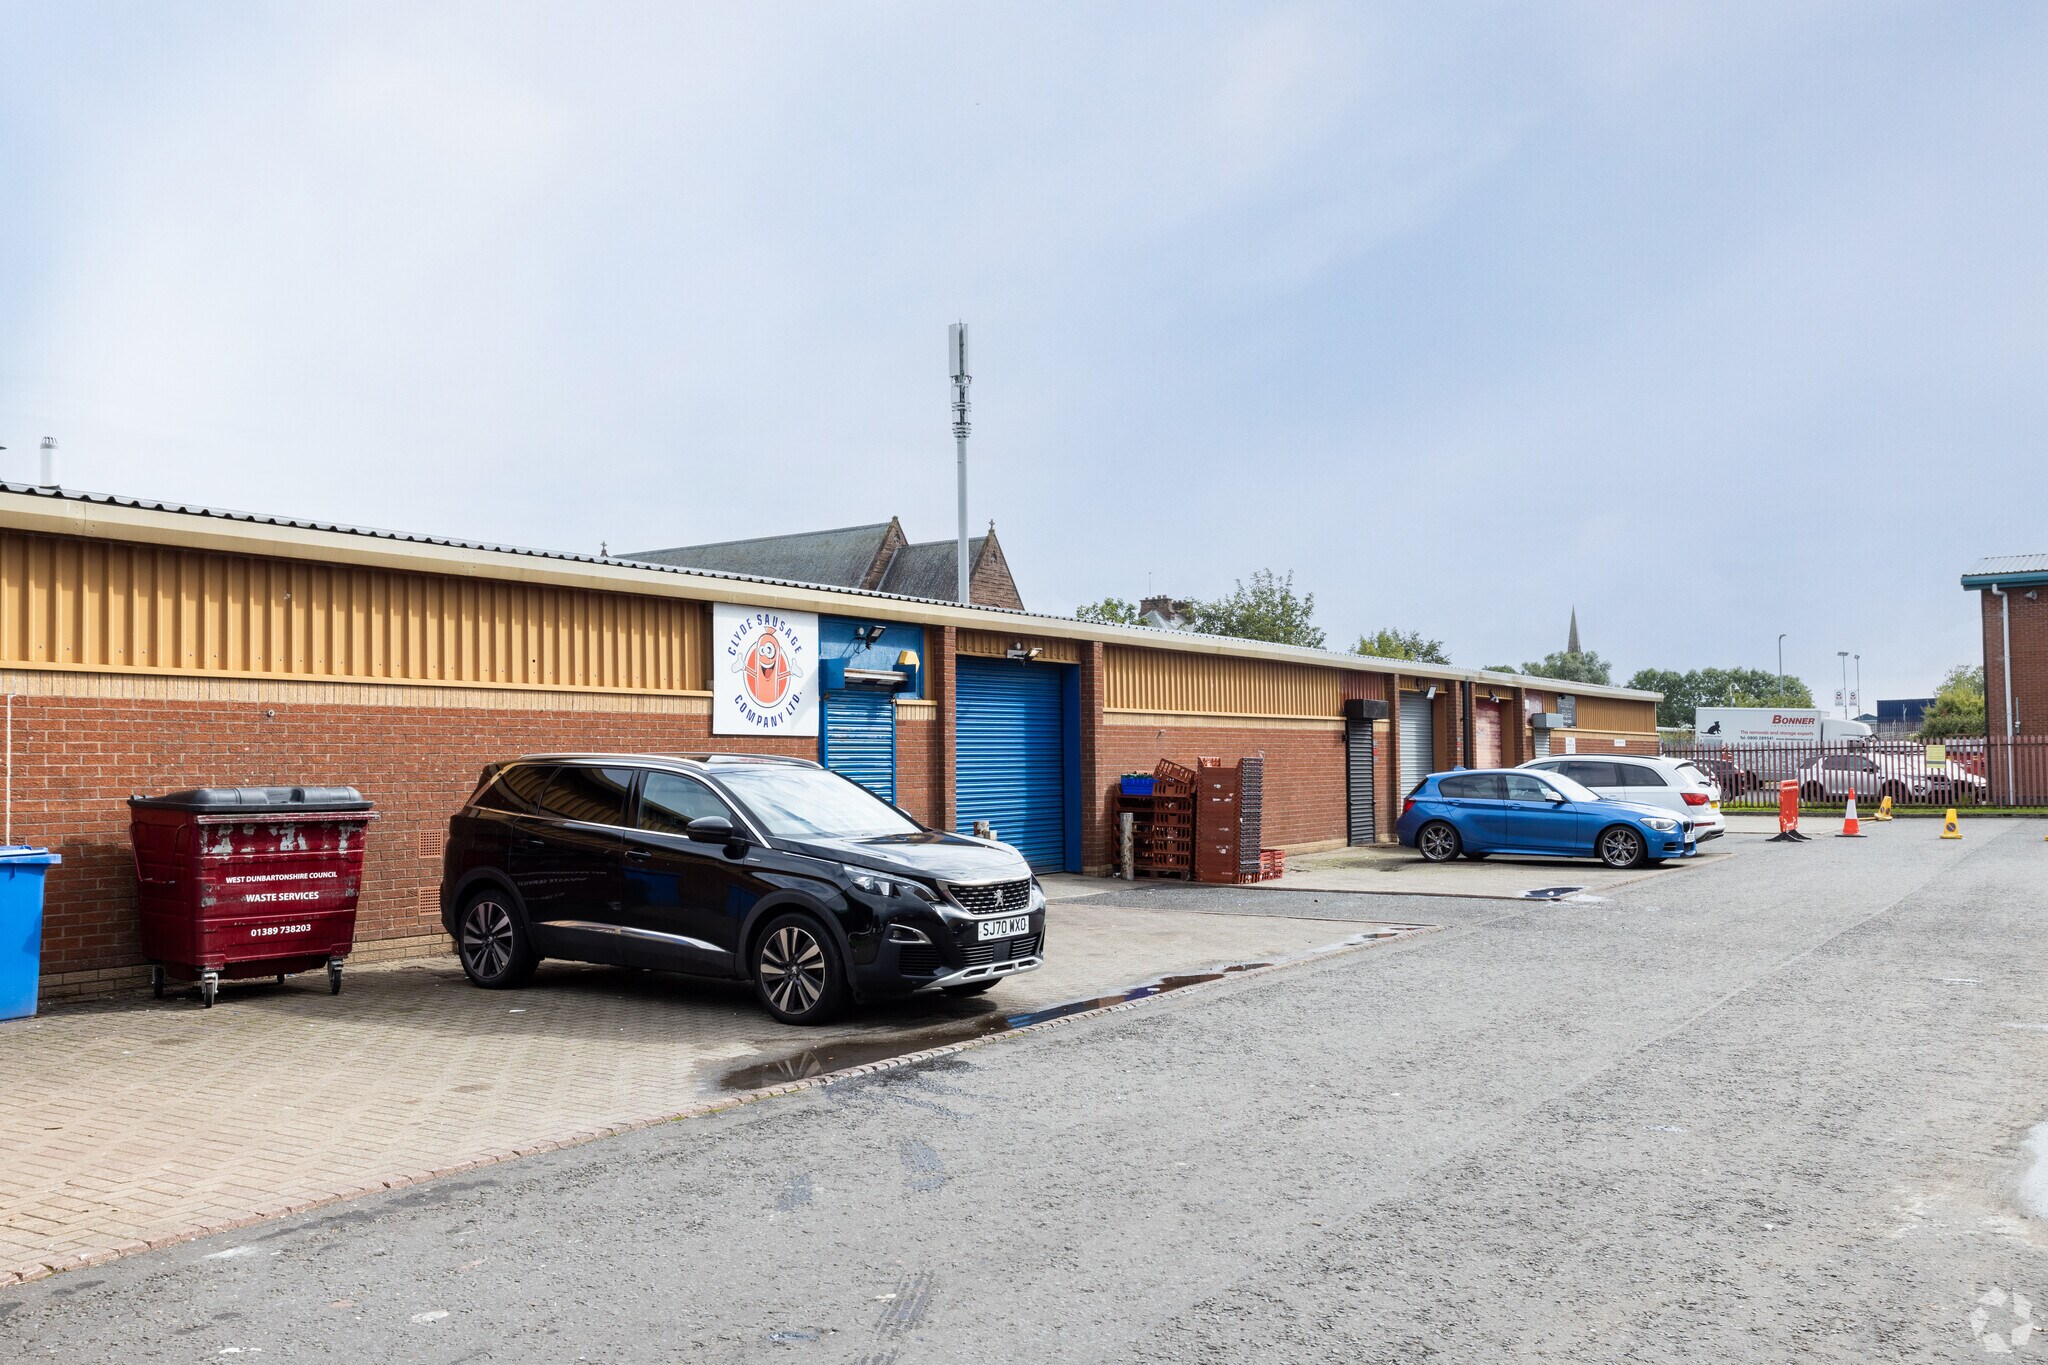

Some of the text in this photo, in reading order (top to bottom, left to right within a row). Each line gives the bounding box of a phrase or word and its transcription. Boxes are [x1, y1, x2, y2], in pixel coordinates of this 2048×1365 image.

[727, 613, 803, 656] CLYDE SAUSAGE
[734, 691, 802, 728] COMPANY LTD.
[226, 871, 338, 884] WEST DUNBARTONSHIRE COUNCIL
[246, 891, 320, 903] WASTE SERVICES
[250, 923, 312, 937] 01389 738203
[983, 920, 1007, 936] SJ70
